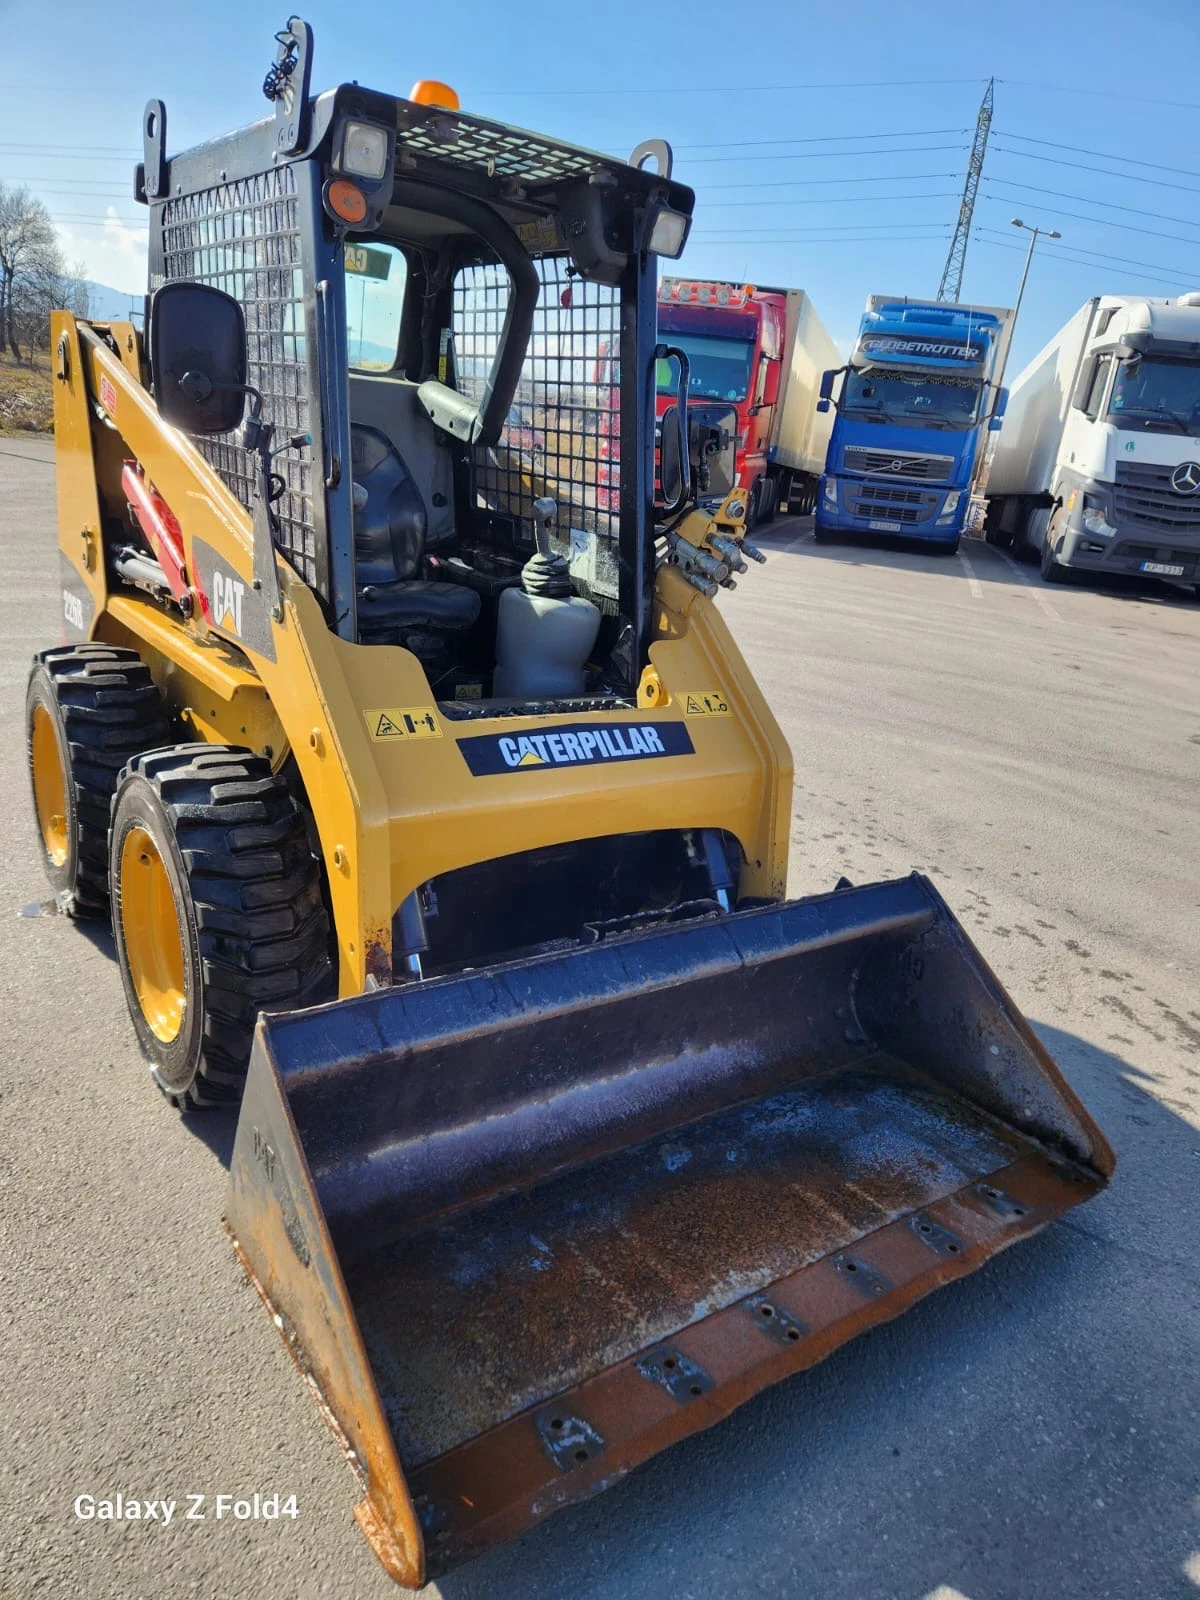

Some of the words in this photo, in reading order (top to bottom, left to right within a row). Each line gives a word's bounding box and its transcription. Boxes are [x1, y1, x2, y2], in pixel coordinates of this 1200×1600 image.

[868, 339, 980, 358] GLOBETROTTER
[213, 571, 244, 638] CAT
[498, 726, 666, 767] CATERPILLAR
